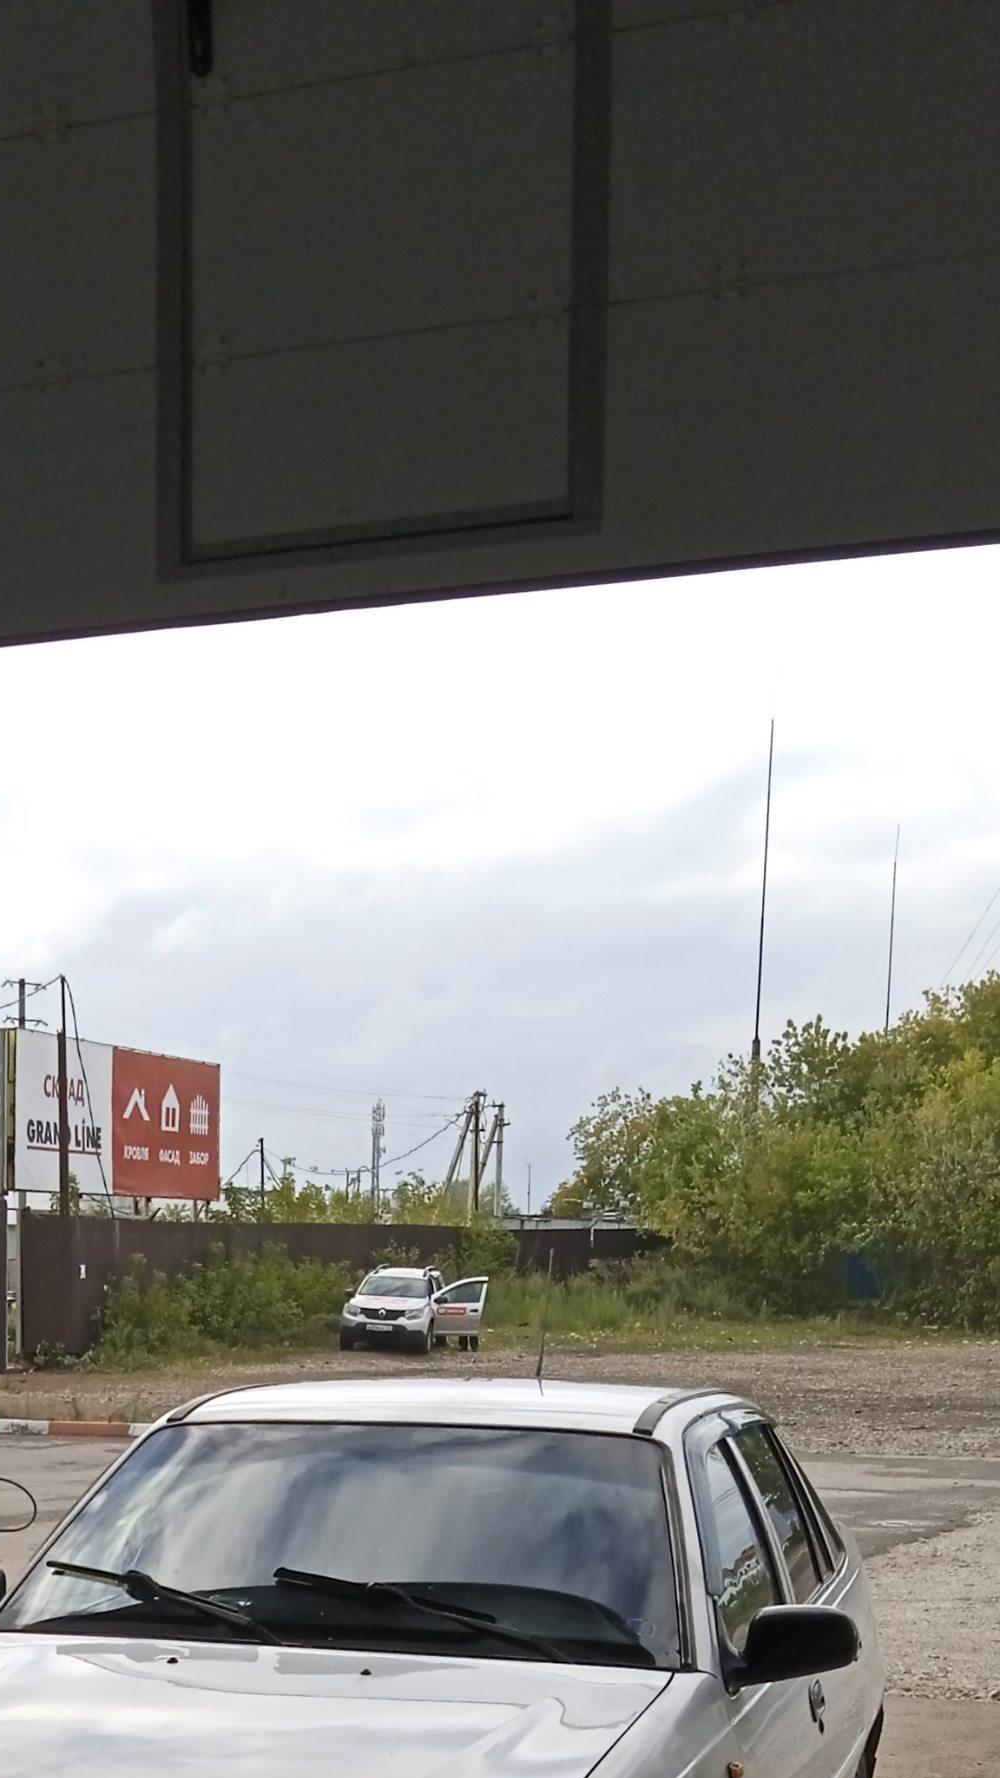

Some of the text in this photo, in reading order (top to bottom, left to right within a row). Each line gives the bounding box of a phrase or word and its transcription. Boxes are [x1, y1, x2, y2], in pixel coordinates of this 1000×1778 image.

[44, 1074, 86, 1107] СКАД
[159, 1149, 181, 1166] ФАСАД
[189, 1150, 210, 1166] ЗАБОР
